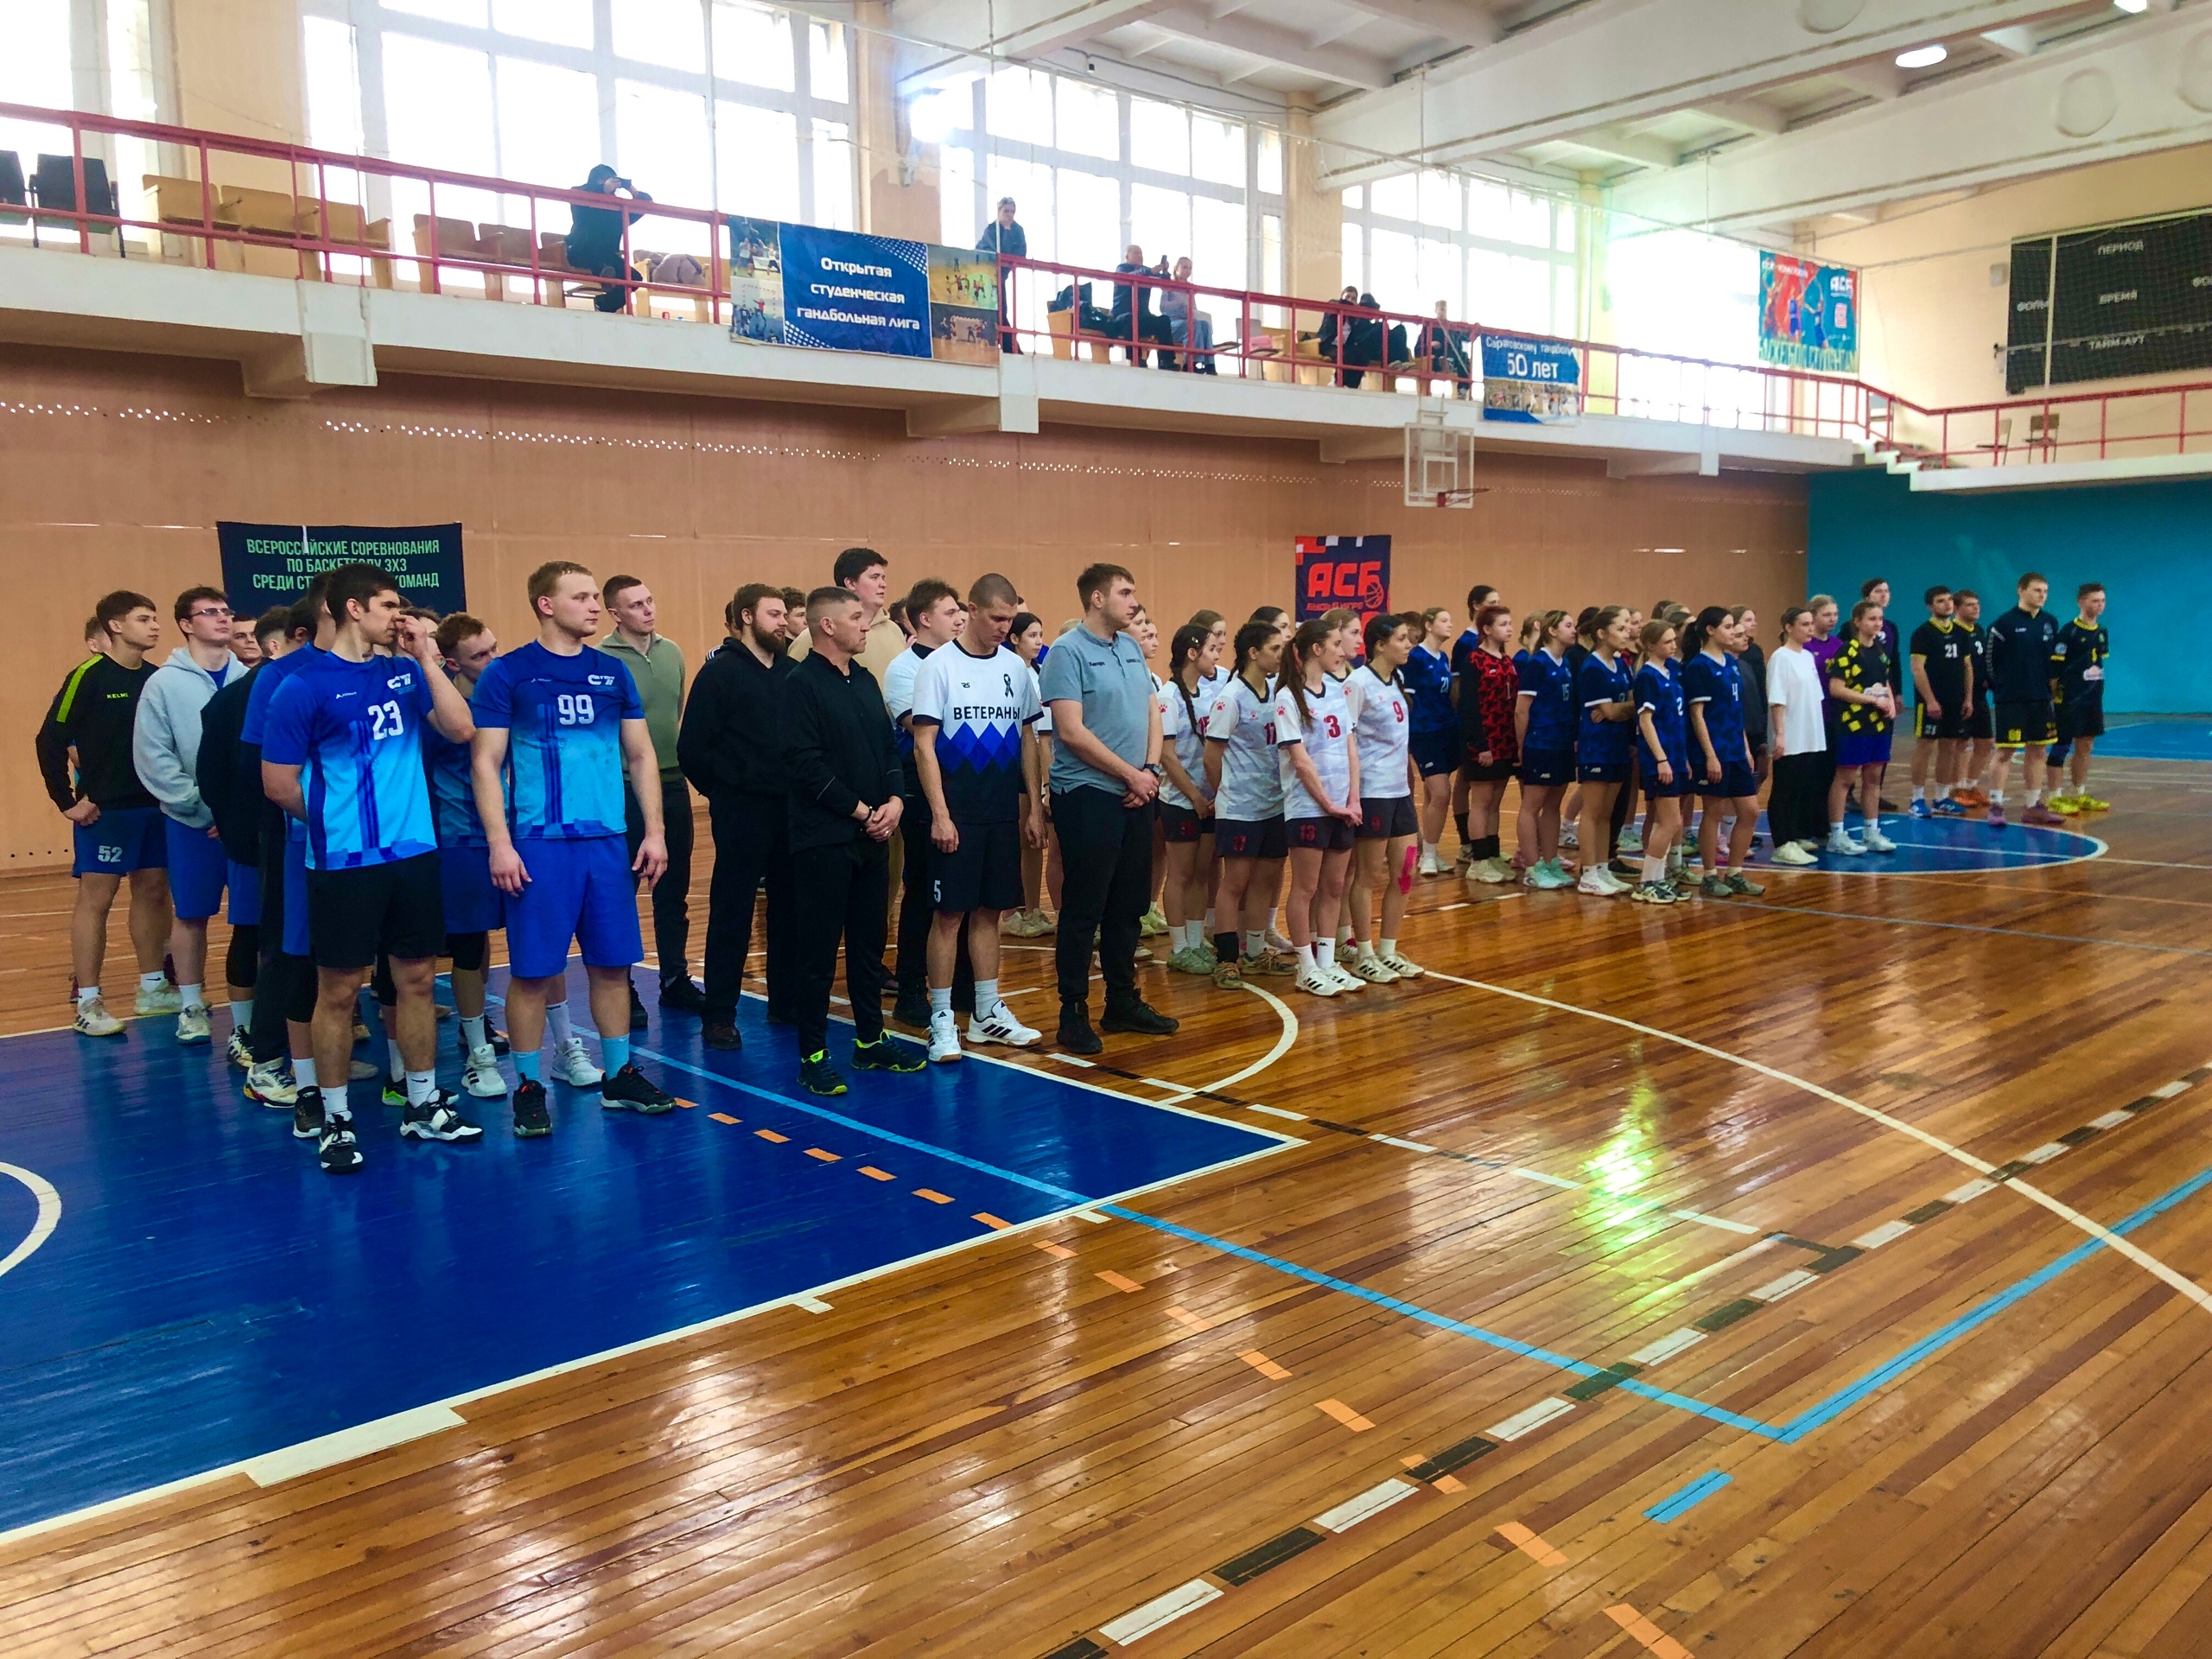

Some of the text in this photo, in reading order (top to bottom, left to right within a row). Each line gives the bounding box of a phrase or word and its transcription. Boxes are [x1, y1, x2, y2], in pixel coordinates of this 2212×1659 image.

[2098, 239, 2144, 255] ПЕРИОД
[821, 257, 892, 278] Открытая
[2192, 276, 2212, 288] ФО
[810, 283, 905, 304] студенческая
[797, 306, 920, 330] гандбольная лига
[1508, 353, 1559, 379] 50 лет
[351, 539, 440, 556] СОРЕВНОВАНИЯ
[286, 558, 303, 572] ПО
[252, 574, 295, 591] СРЕДИ
[395, 572, 440, 588] ОМАНД
[1944, 643, 1958, 658] 21
[557, 694, 595, 725] 99
[953, 706, 1020, 721] ВЕТЕРАНЫ
[1392, 701, 1405, 723] 9
[367, 700, 404, 741] 23
[1300, 823, 1317, 842] 13
[98, 845, 123, 862] 52
[933, 880, 941, 903] 5
